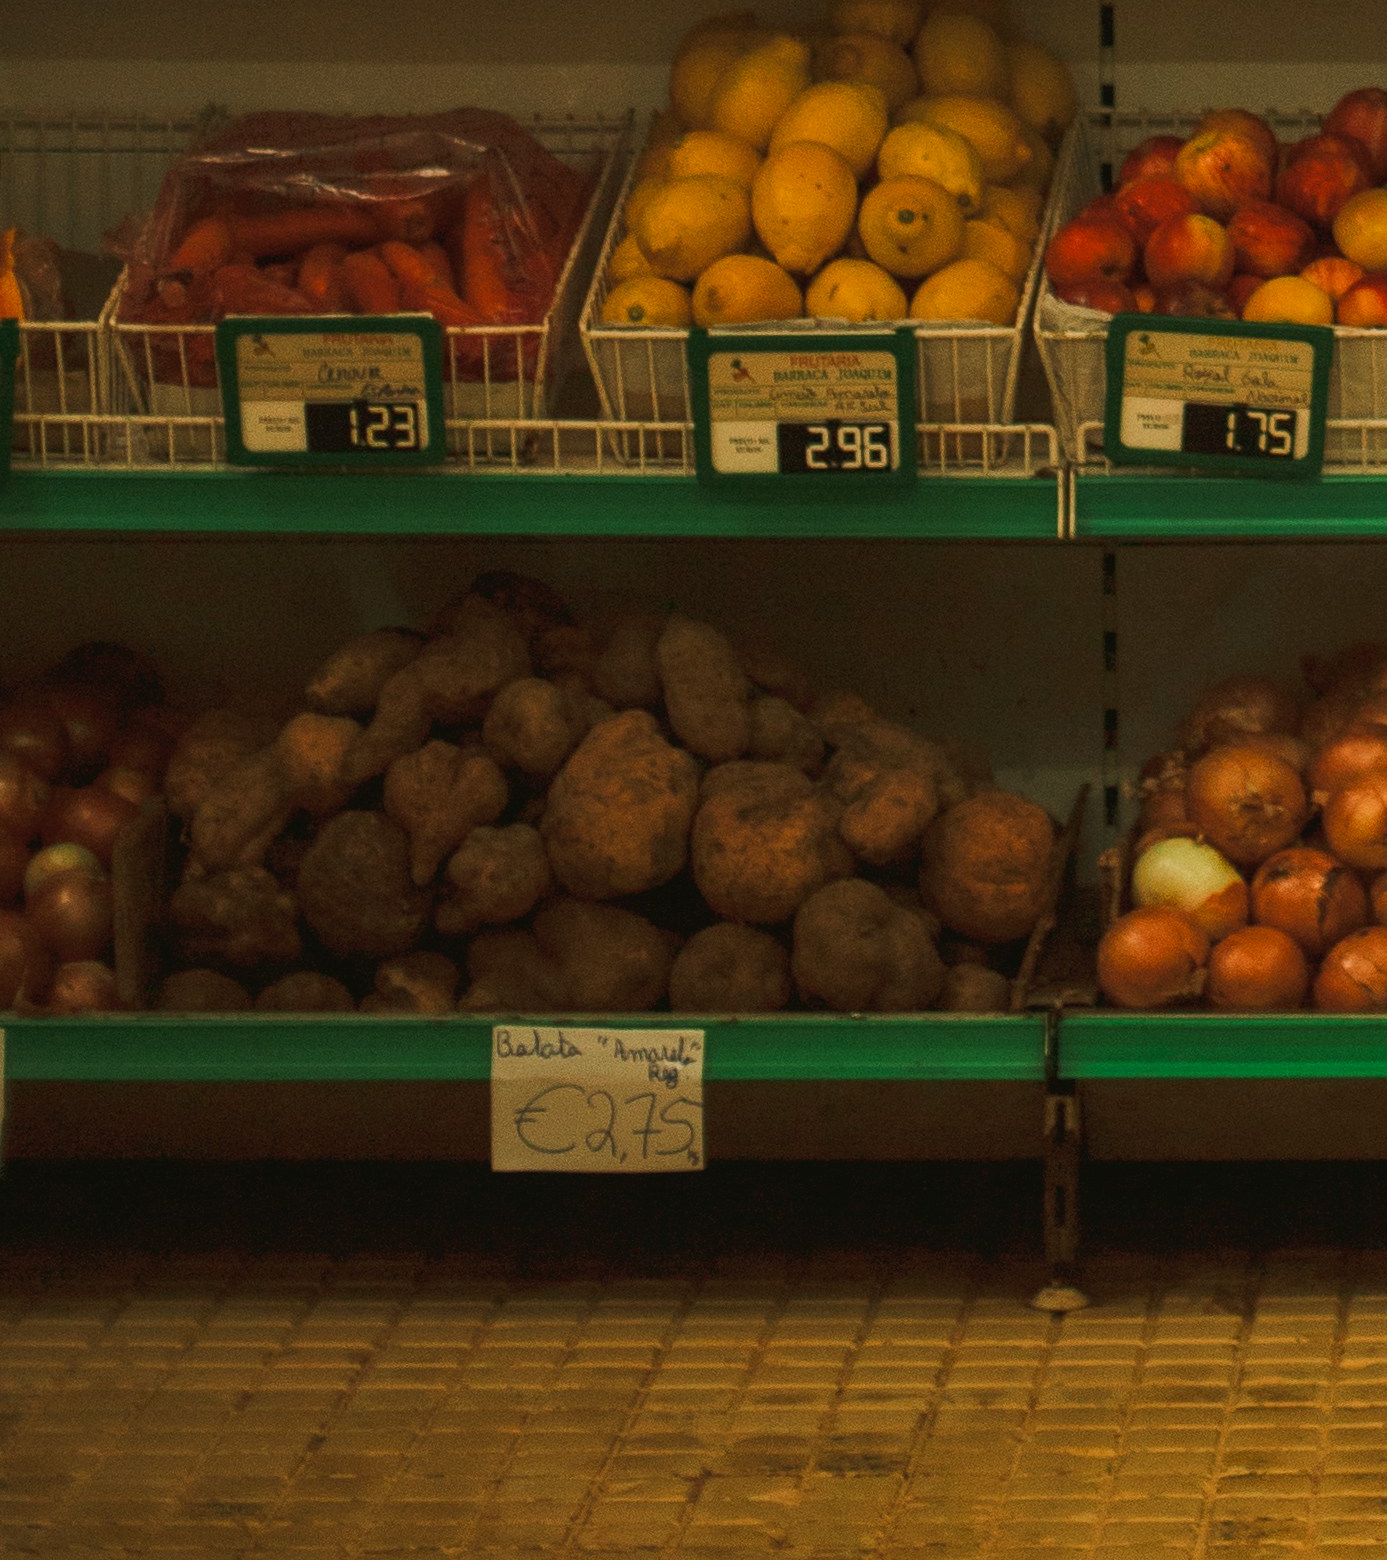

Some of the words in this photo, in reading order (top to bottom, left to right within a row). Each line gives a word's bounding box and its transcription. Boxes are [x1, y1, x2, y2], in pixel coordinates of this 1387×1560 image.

[350, 405, 415, 449] 1.23
[806, 426, 888, 469] 2.96
[1226, 411, 1292, 457] 1.75
[514, 1083, 704, 1164] €2,75
